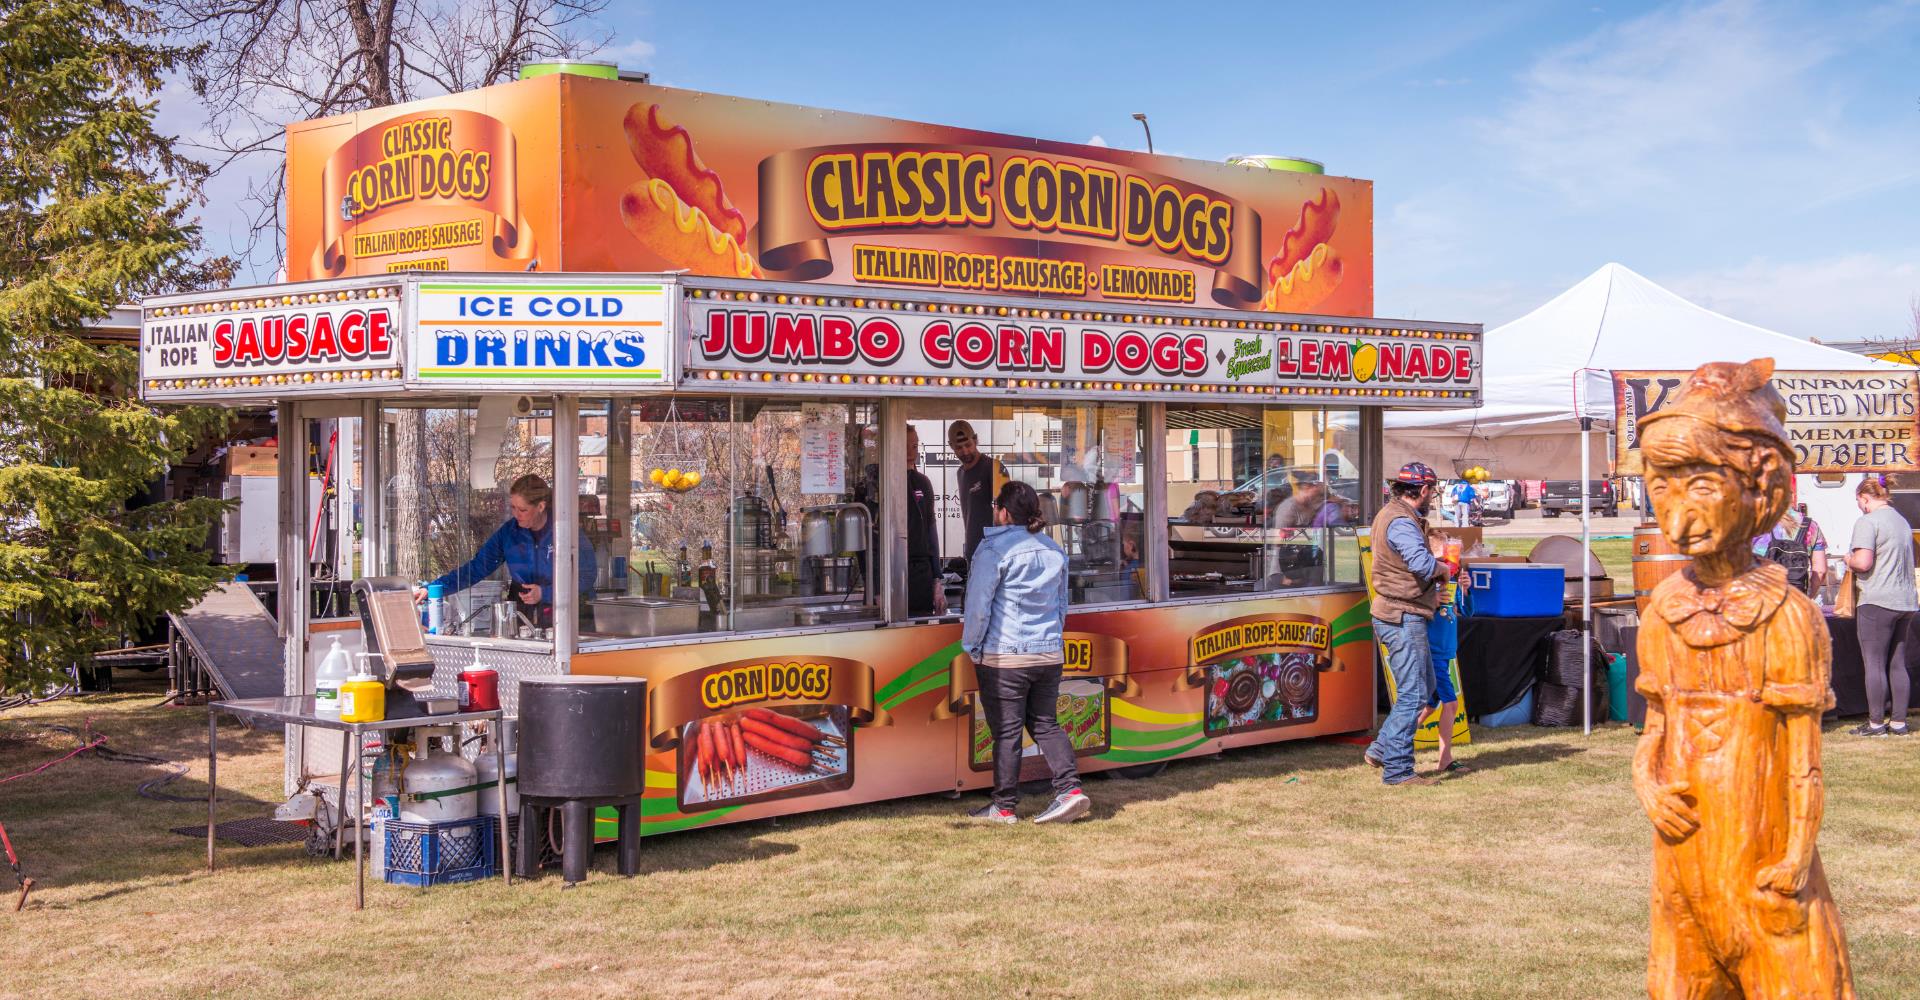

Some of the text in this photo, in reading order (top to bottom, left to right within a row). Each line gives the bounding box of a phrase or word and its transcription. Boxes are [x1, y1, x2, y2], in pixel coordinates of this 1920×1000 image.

[383, 119, 450, 157] CLASSIC
[348, 151, 490, 213] CORN DOGS
[807, 154, 1232, 261] CLASSIC CORN DOGS
[354, 221, 482, 256] ITALIAN ROPE SAUSAGE
[854, 246, 1194, 301] ITALIAN ROPE SAUSAGE LEMONADE
[459, 296, 623, 317] ICE COLD
[151, 322, 208, 346] ITALIAN
[212, 308, 393, 368] SAUSAGE
[435, 329, 646, 368] DRINKS
[700, 309, 1209, 379] JUMBO CORN DOGS
[1234, 334, 1262, 359] Fresh
[160, 346, 198, 367] ROPE
[1226, 348, 1272, 381] Squeezed
[1775, 378, 1908, 390] NNAMON
[1786, 393, 1915, 416] STED NUTS
[1790, 428, 1912, 441] MEMADE
[1195, 623, 1326, 659] ITALIAN ROPE SAUSAGE
[704, 664, 829, 706] CORN DOGS
